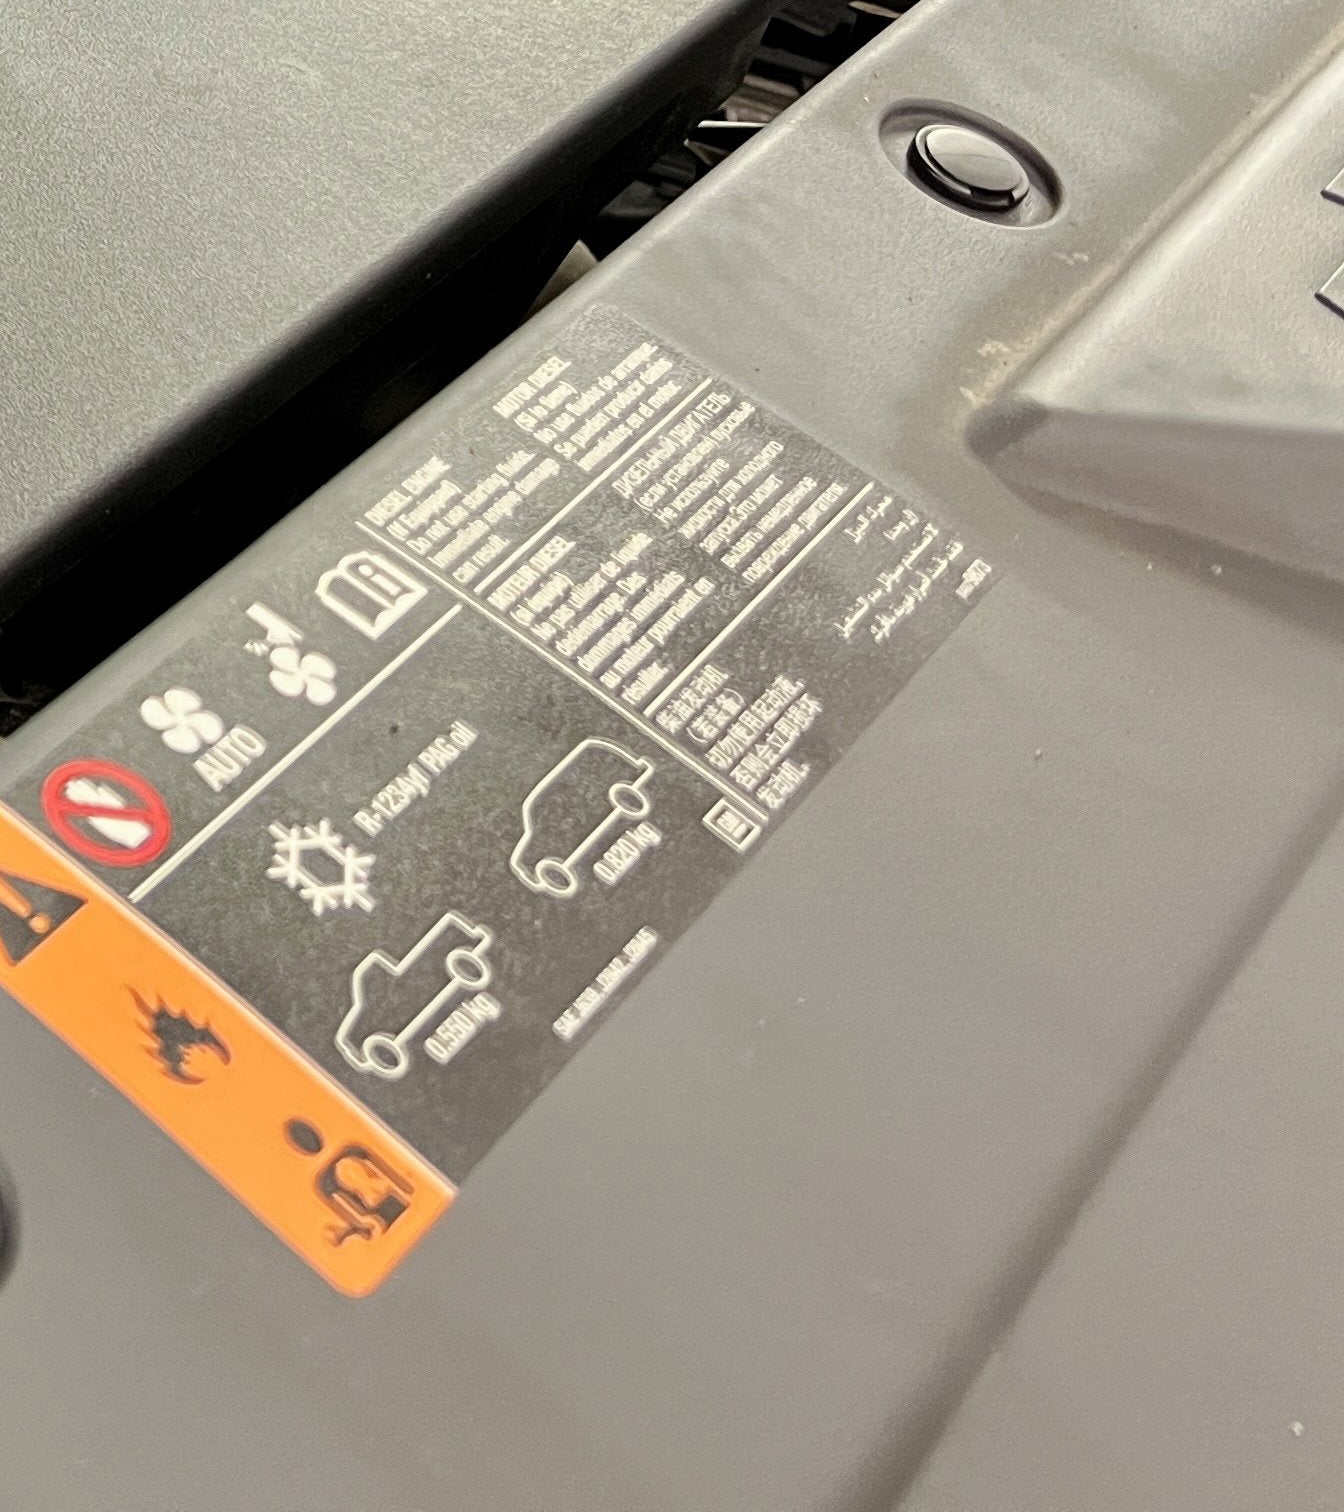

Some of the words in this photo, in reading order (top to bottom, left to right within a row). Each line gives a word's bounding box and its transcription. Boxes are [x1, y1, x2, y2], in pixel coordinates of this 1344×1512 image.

[191, 723, 267, 792] AUTO
[416, 735, 461, 775] PAG
[448, 719, 478, 750] oil
[592, 834, 645, 886] 0.820
[625, 821, 661, 851] kg
[423, 1006, 482, 1065] 0.550
[462, 992, 500, 1023] kg
